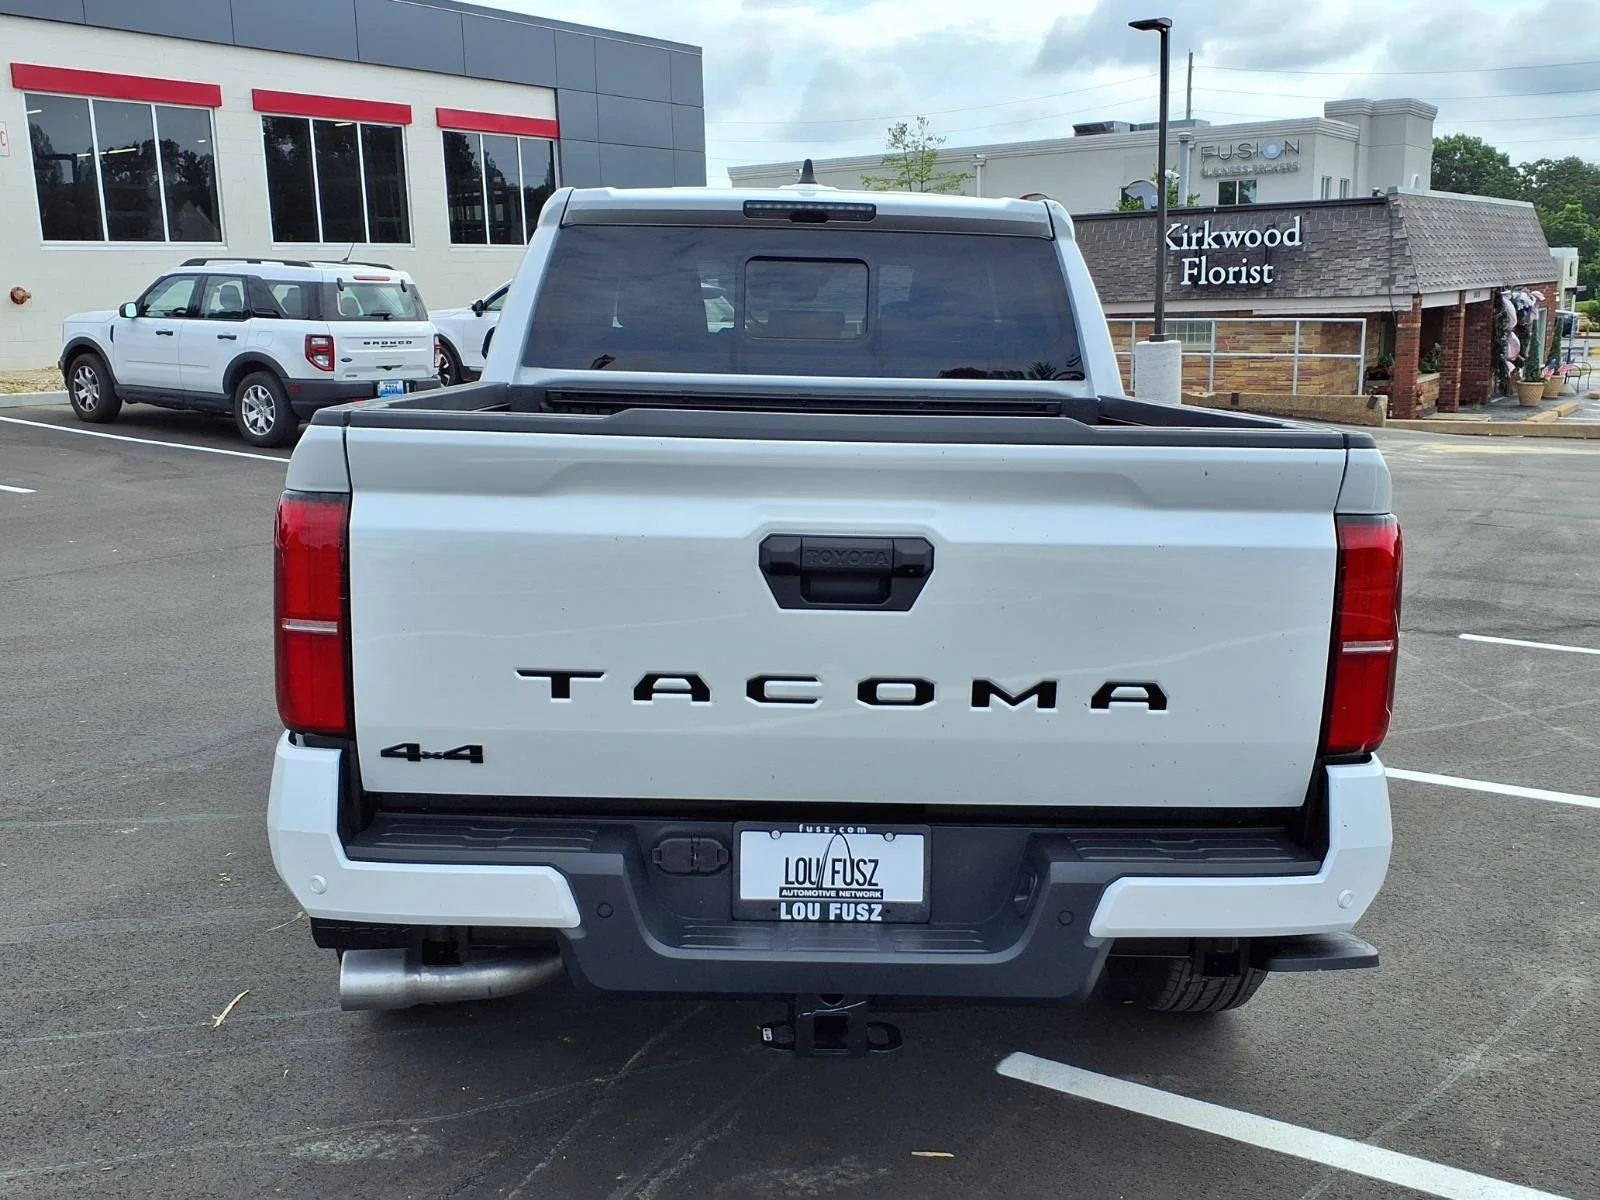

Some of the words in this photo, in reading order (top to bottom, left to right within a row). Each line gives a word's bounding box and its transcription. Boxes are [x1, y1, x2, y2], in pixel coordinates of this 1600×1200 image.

[1200, 139, 1300, 163] FUSION
[1165, 216, 1303, 251] Kirkwood
[1181, 257, 1274, 286] Florist
[807, 549, 889, 567] TOYOTA
[514, 668, 1169, 713] TACOMA
[798, 823, 867, 834] fusz.com
[784, 856, 821, 886] LOU
[830, 857, 880, 887] FUSZ
[781, 888, 837, 898] AUTOMOTIVE
[838, 889, 882, 899] NETWORK
[780, 901, 821, 920] LOU
[829, 902, 883, 921] FUSZ
